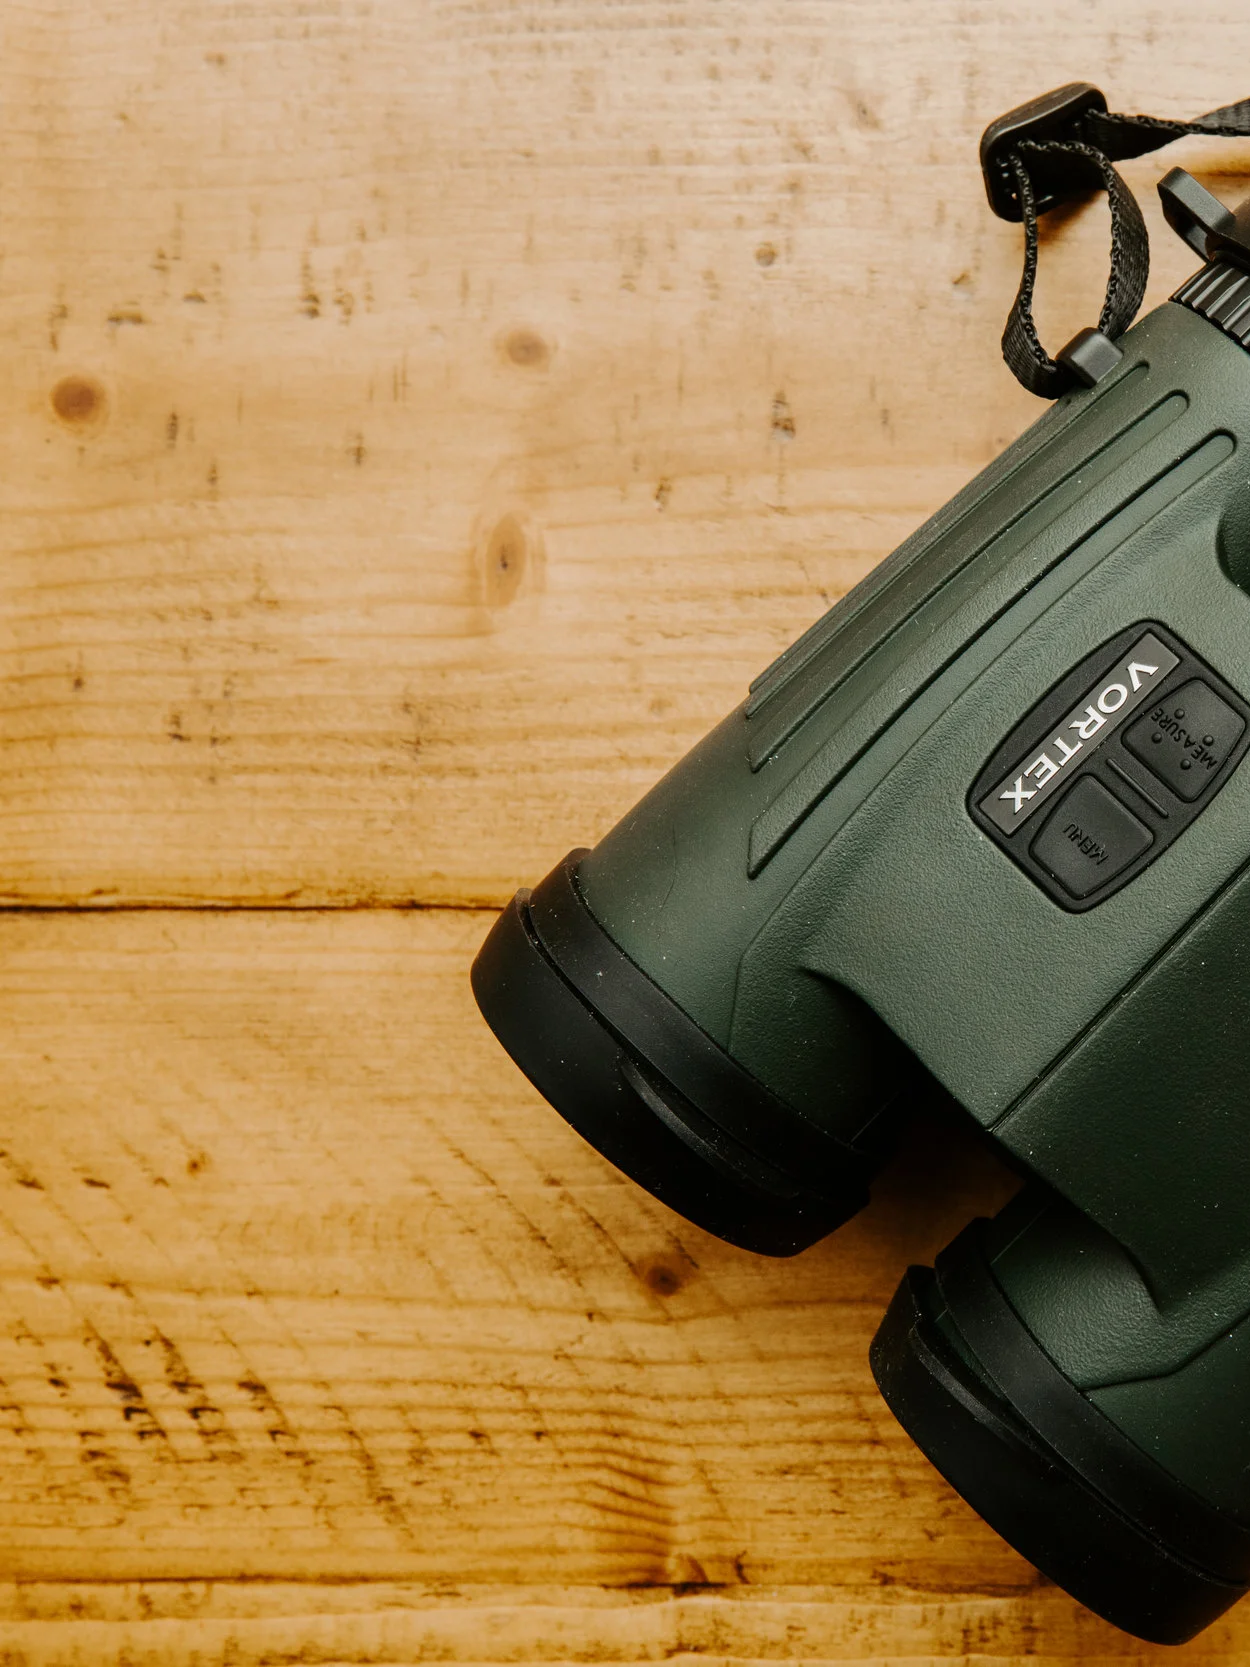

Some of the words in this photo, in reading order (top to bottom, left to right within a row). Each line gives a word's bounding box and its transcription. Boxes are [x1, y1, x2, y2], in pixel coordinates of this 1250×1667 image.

[999, 661, 1159, 814] VORTEX
[1150, 707, 1217, 770] MEASURE
[1062, 822, 1109, 866] MENU
